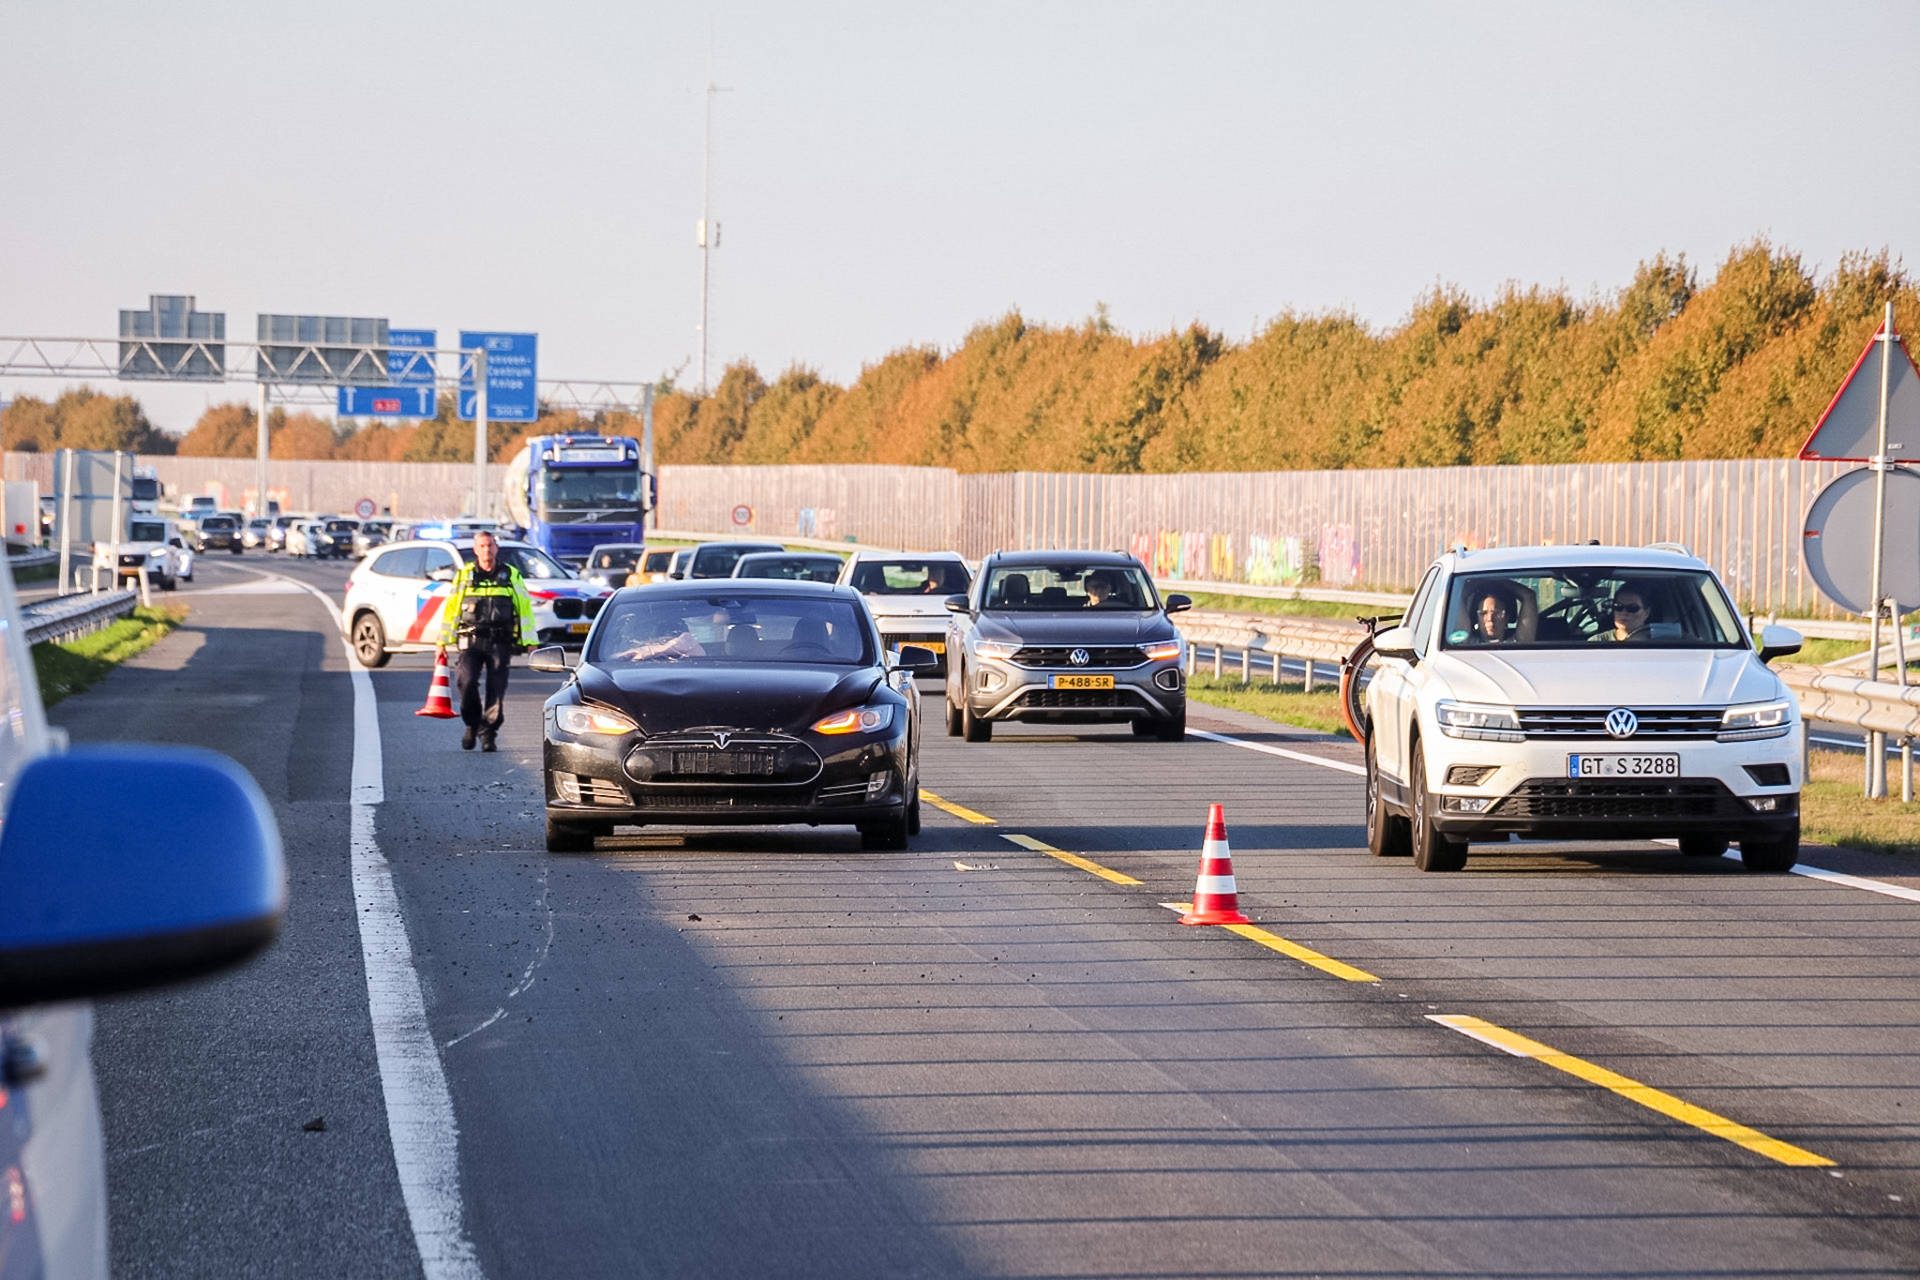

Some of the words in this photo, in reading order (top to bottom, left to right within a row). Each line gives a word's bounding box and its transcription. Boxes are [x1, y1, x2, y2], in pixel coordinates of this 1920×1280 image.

[1058, 677, 1109, 688] P-488-SR
[1581, 758, 1604, 774] GT
[1616, 758, 1628, 774] S
[1632, 758, 1676, 774] 3288
